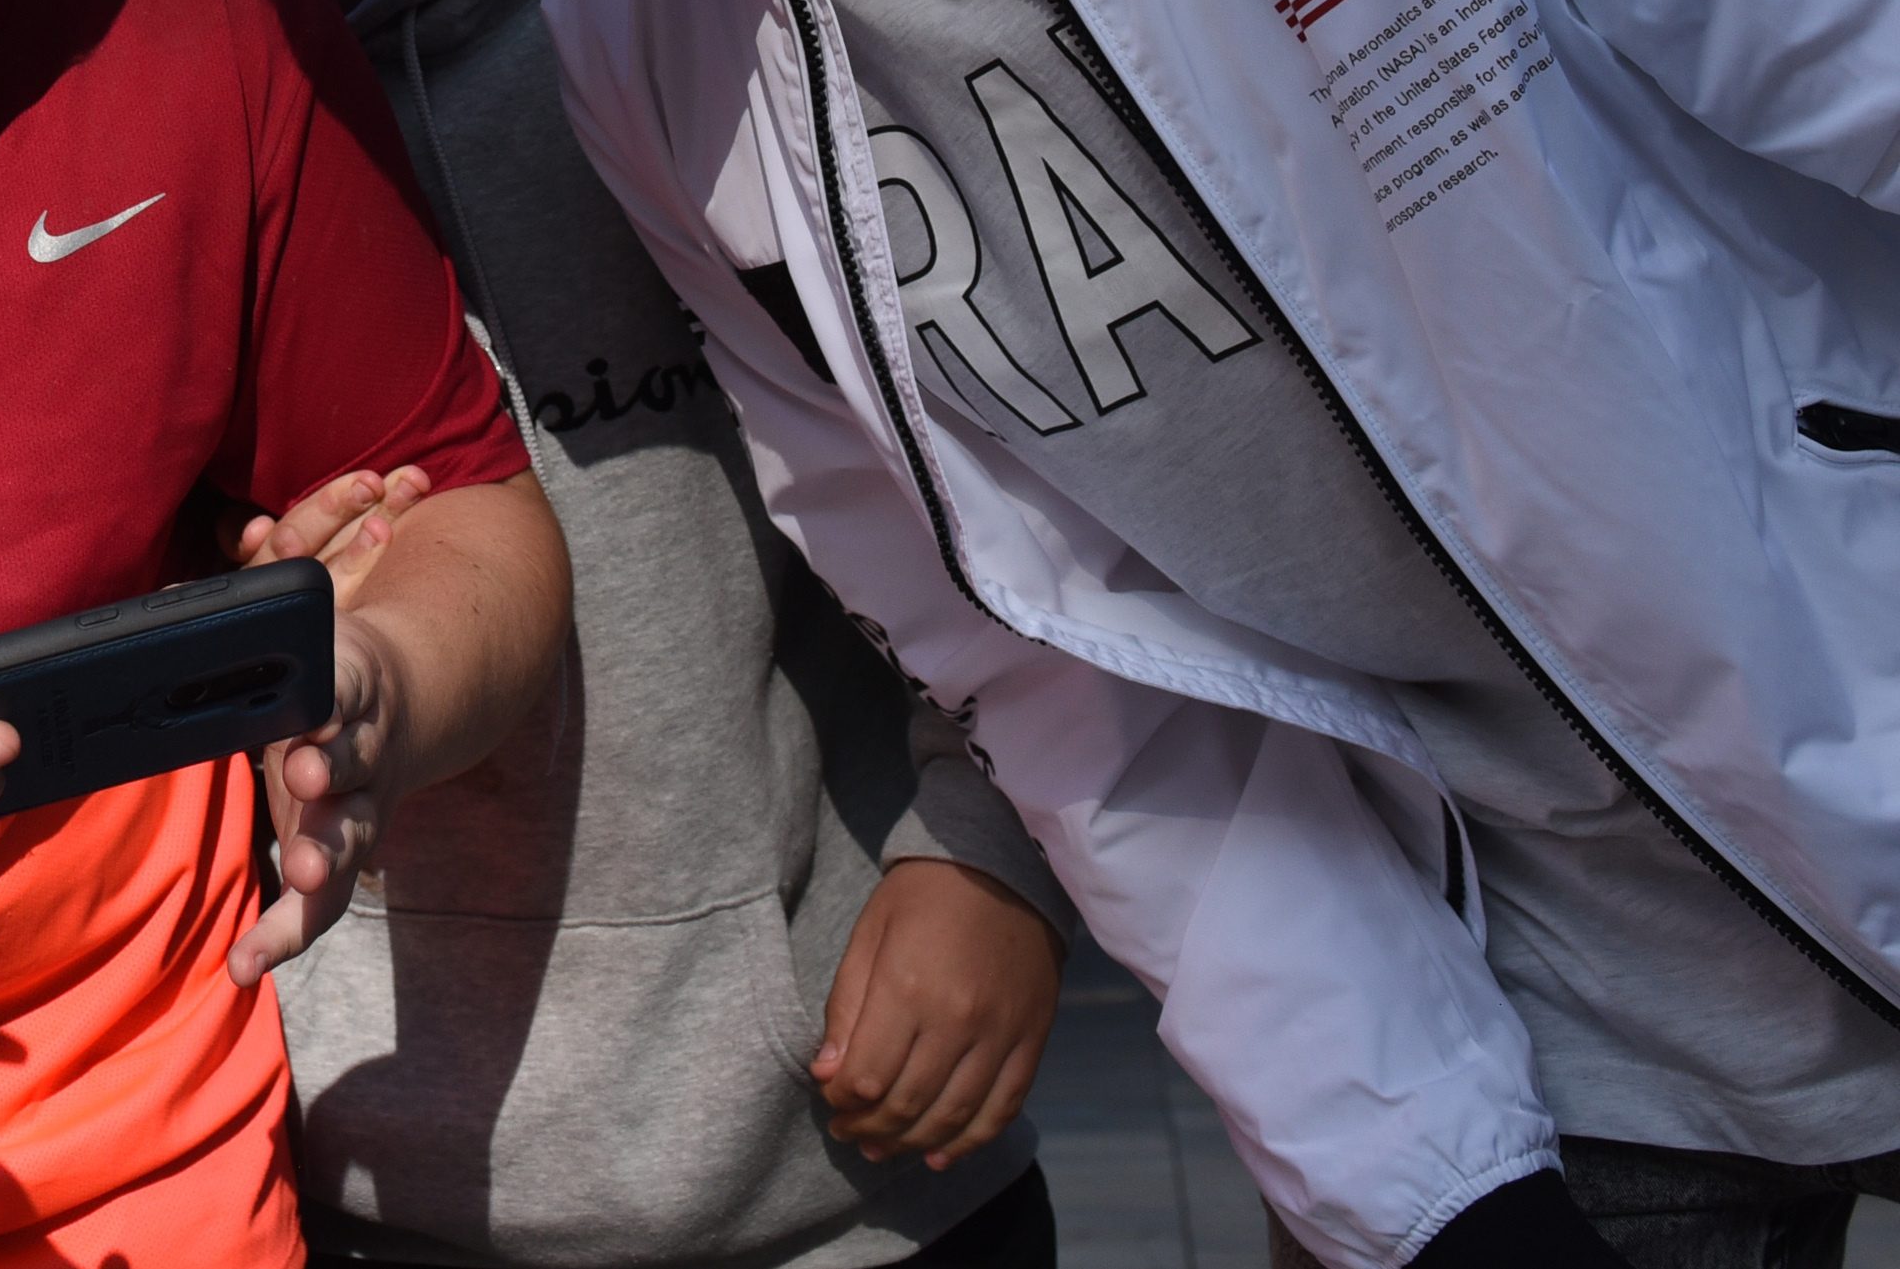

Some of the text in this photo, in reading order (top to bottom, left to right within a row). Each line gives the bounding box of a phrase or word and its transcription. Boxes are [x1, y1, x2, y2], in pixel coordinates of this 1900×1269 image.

[1347, 4, 1423, 68] Aeronautics
[1376, 38, 1428, 83] (NASA)
[1422, 31, 1439, 47] is
[1437, 17, 1459, 37] an
[1360, 117, 1375, 136] of
[1371, 104, 1397, 125] the
[1393, 67, 1441, 107] United
[1437, 41, 1480, 75] States
[1361, 133, 1408, 173] ernment
[1406, 83, 1477, 140] responsible
[1474, 65, 1498, 87] for
[1495, 48, 1519, 71] the
[1373, 51, 1556, 204] ace program, as well as aeronau
[867, 23, 1265, 437] RA
[1385, 148, 1499, 234] erospace research.
